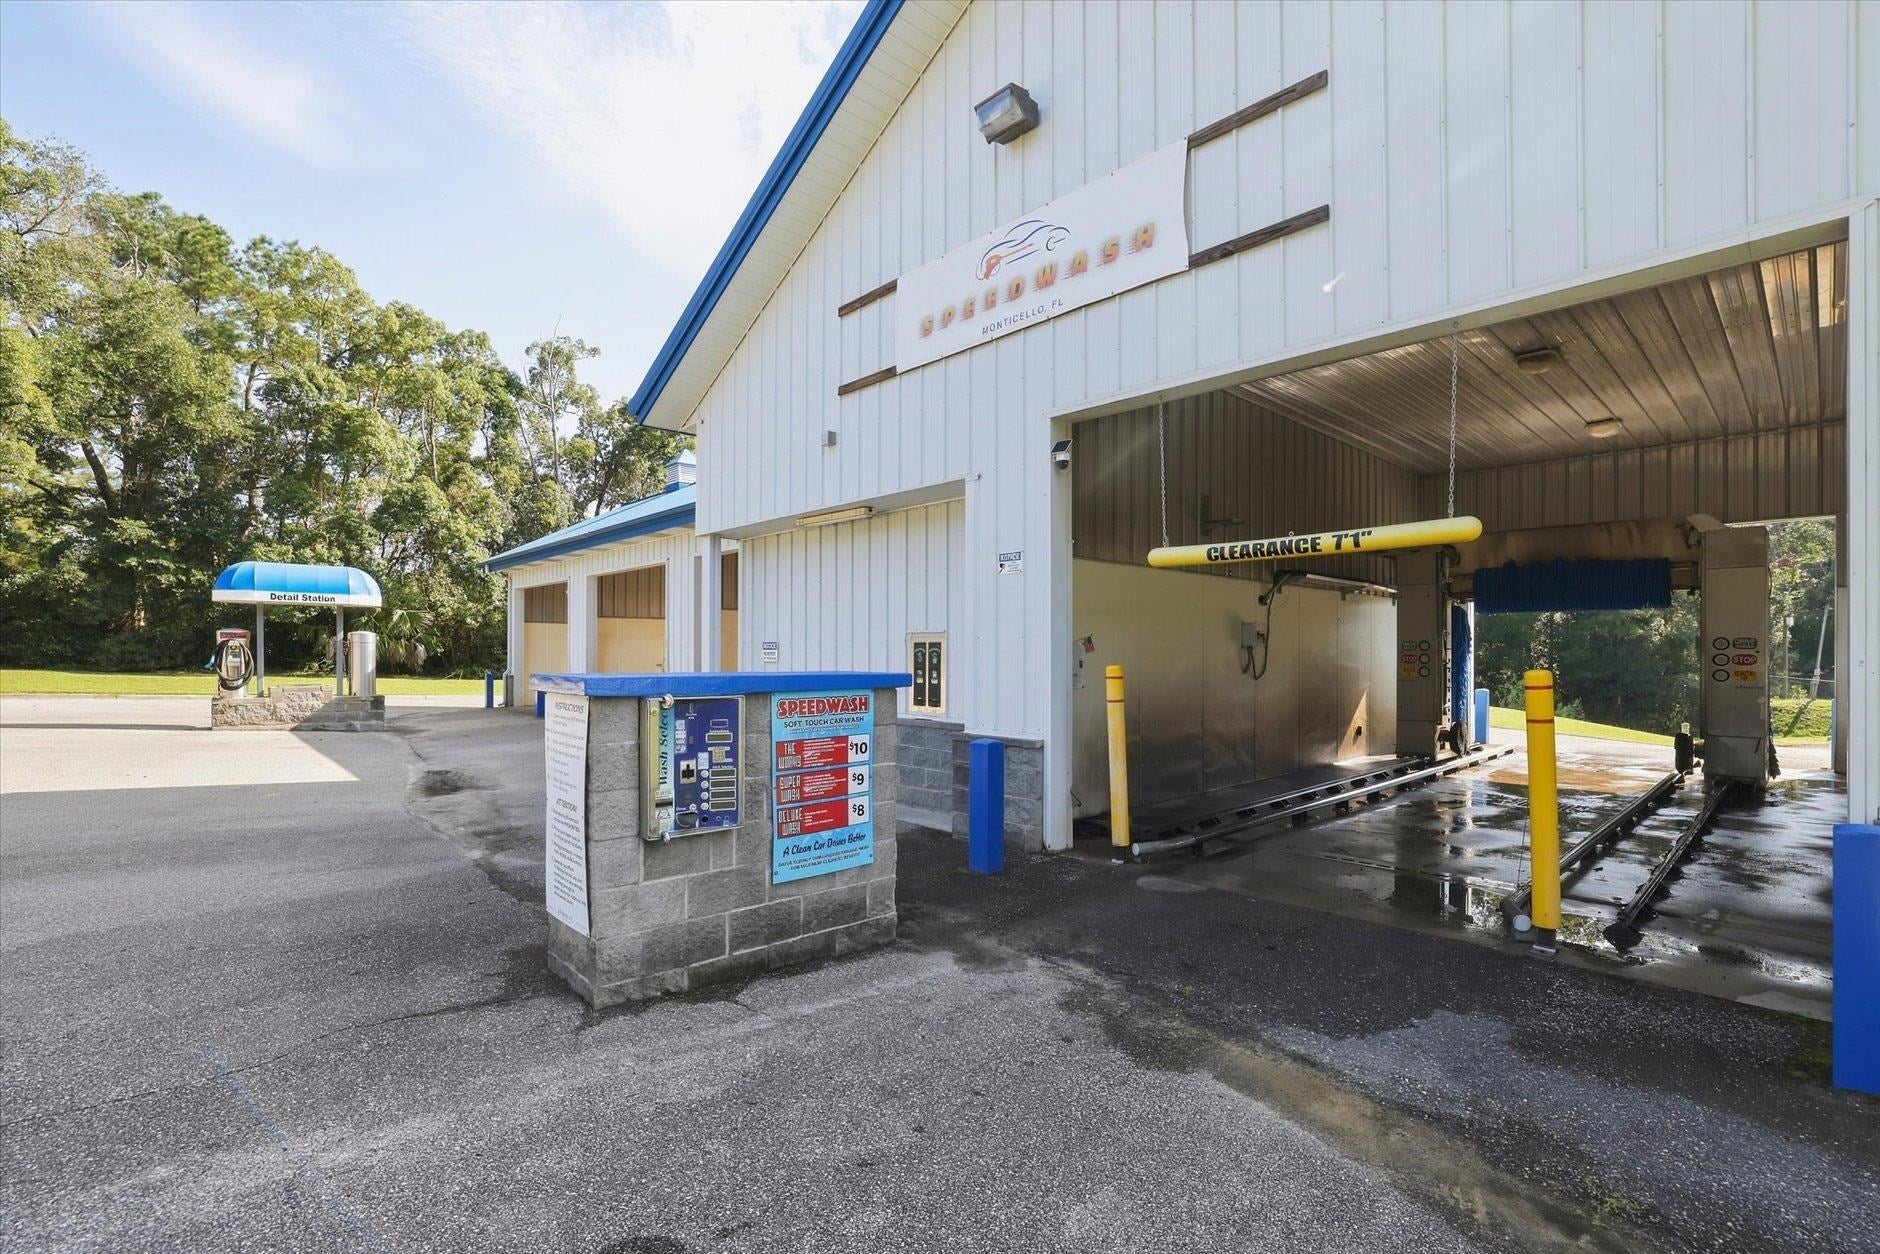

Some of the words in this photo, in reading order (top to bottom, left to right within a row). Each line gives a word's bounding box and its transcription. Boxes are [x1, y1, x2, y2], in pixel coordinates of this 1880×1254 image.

[920, 222, 1157, 338] SPEEDWASH
[982, 304, 1047, 335] MONTICELLO,
[1051, 298, 1064, 309] FL
[1207, 537, 1322, 561] CLEARANCE
[270, 593, 299, 602] Detail
[301, 594, 336, 603] Station
[1732, 655, 1757, 664] STOP
[777, 695, 869, 718] SPEEDWASH
[659, 707, 668, 747] Selec
[783, 719, 802, 728] SOFT
[804, 717, 829, 726] TOUCH
[829, 717, 844, 725] CAR
[844, 716, 864, 724] WASH
[784, 742, 796, 755] THE
[849, 741, 868, 755] $10
[659, 751, 668, 785] Wash
[779, 775, 801, 789] SUPER
[852, 772, 865, 786] $9
[781, 788, 800, 802] WASH
[852, 803, 865, 817] $8
[783, 846, 790, 858] A
[791, 842, 812, 855] Clean
[813, 840, 826, 850] Car
[827, 837, 847, 848] Drives
[847, 832, 867, 845] Better
